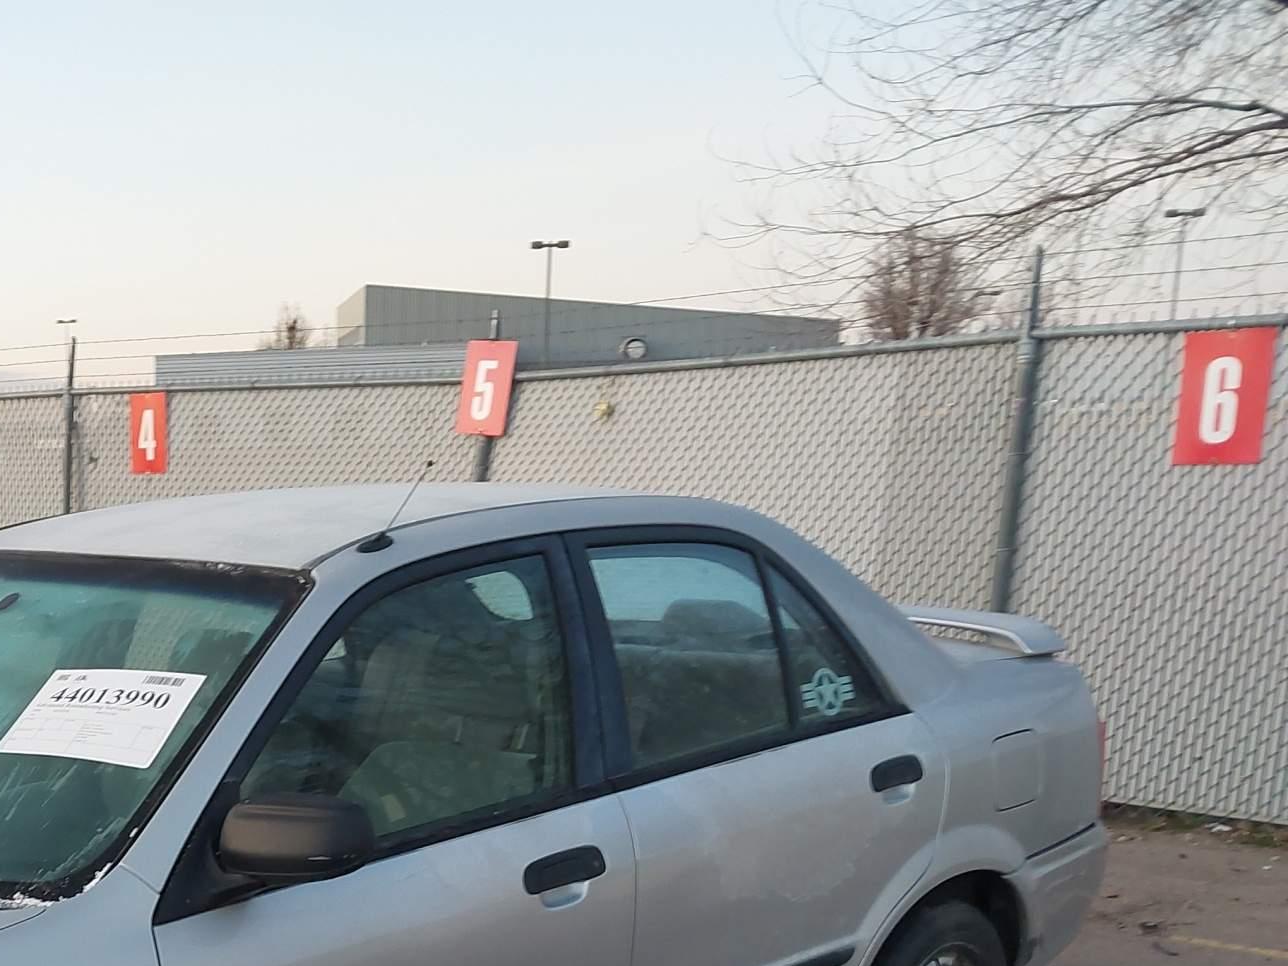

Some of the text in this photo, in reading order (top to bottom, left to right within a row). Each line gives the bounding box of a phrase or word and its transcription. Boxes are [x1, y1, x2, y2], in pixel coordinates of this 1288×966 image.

[469, 359, 499, 421] 5
[1199, 356, 1243, 444] 6
[138, 409, 156, 460] 4
[50, 687, 172, 709] 44013990
